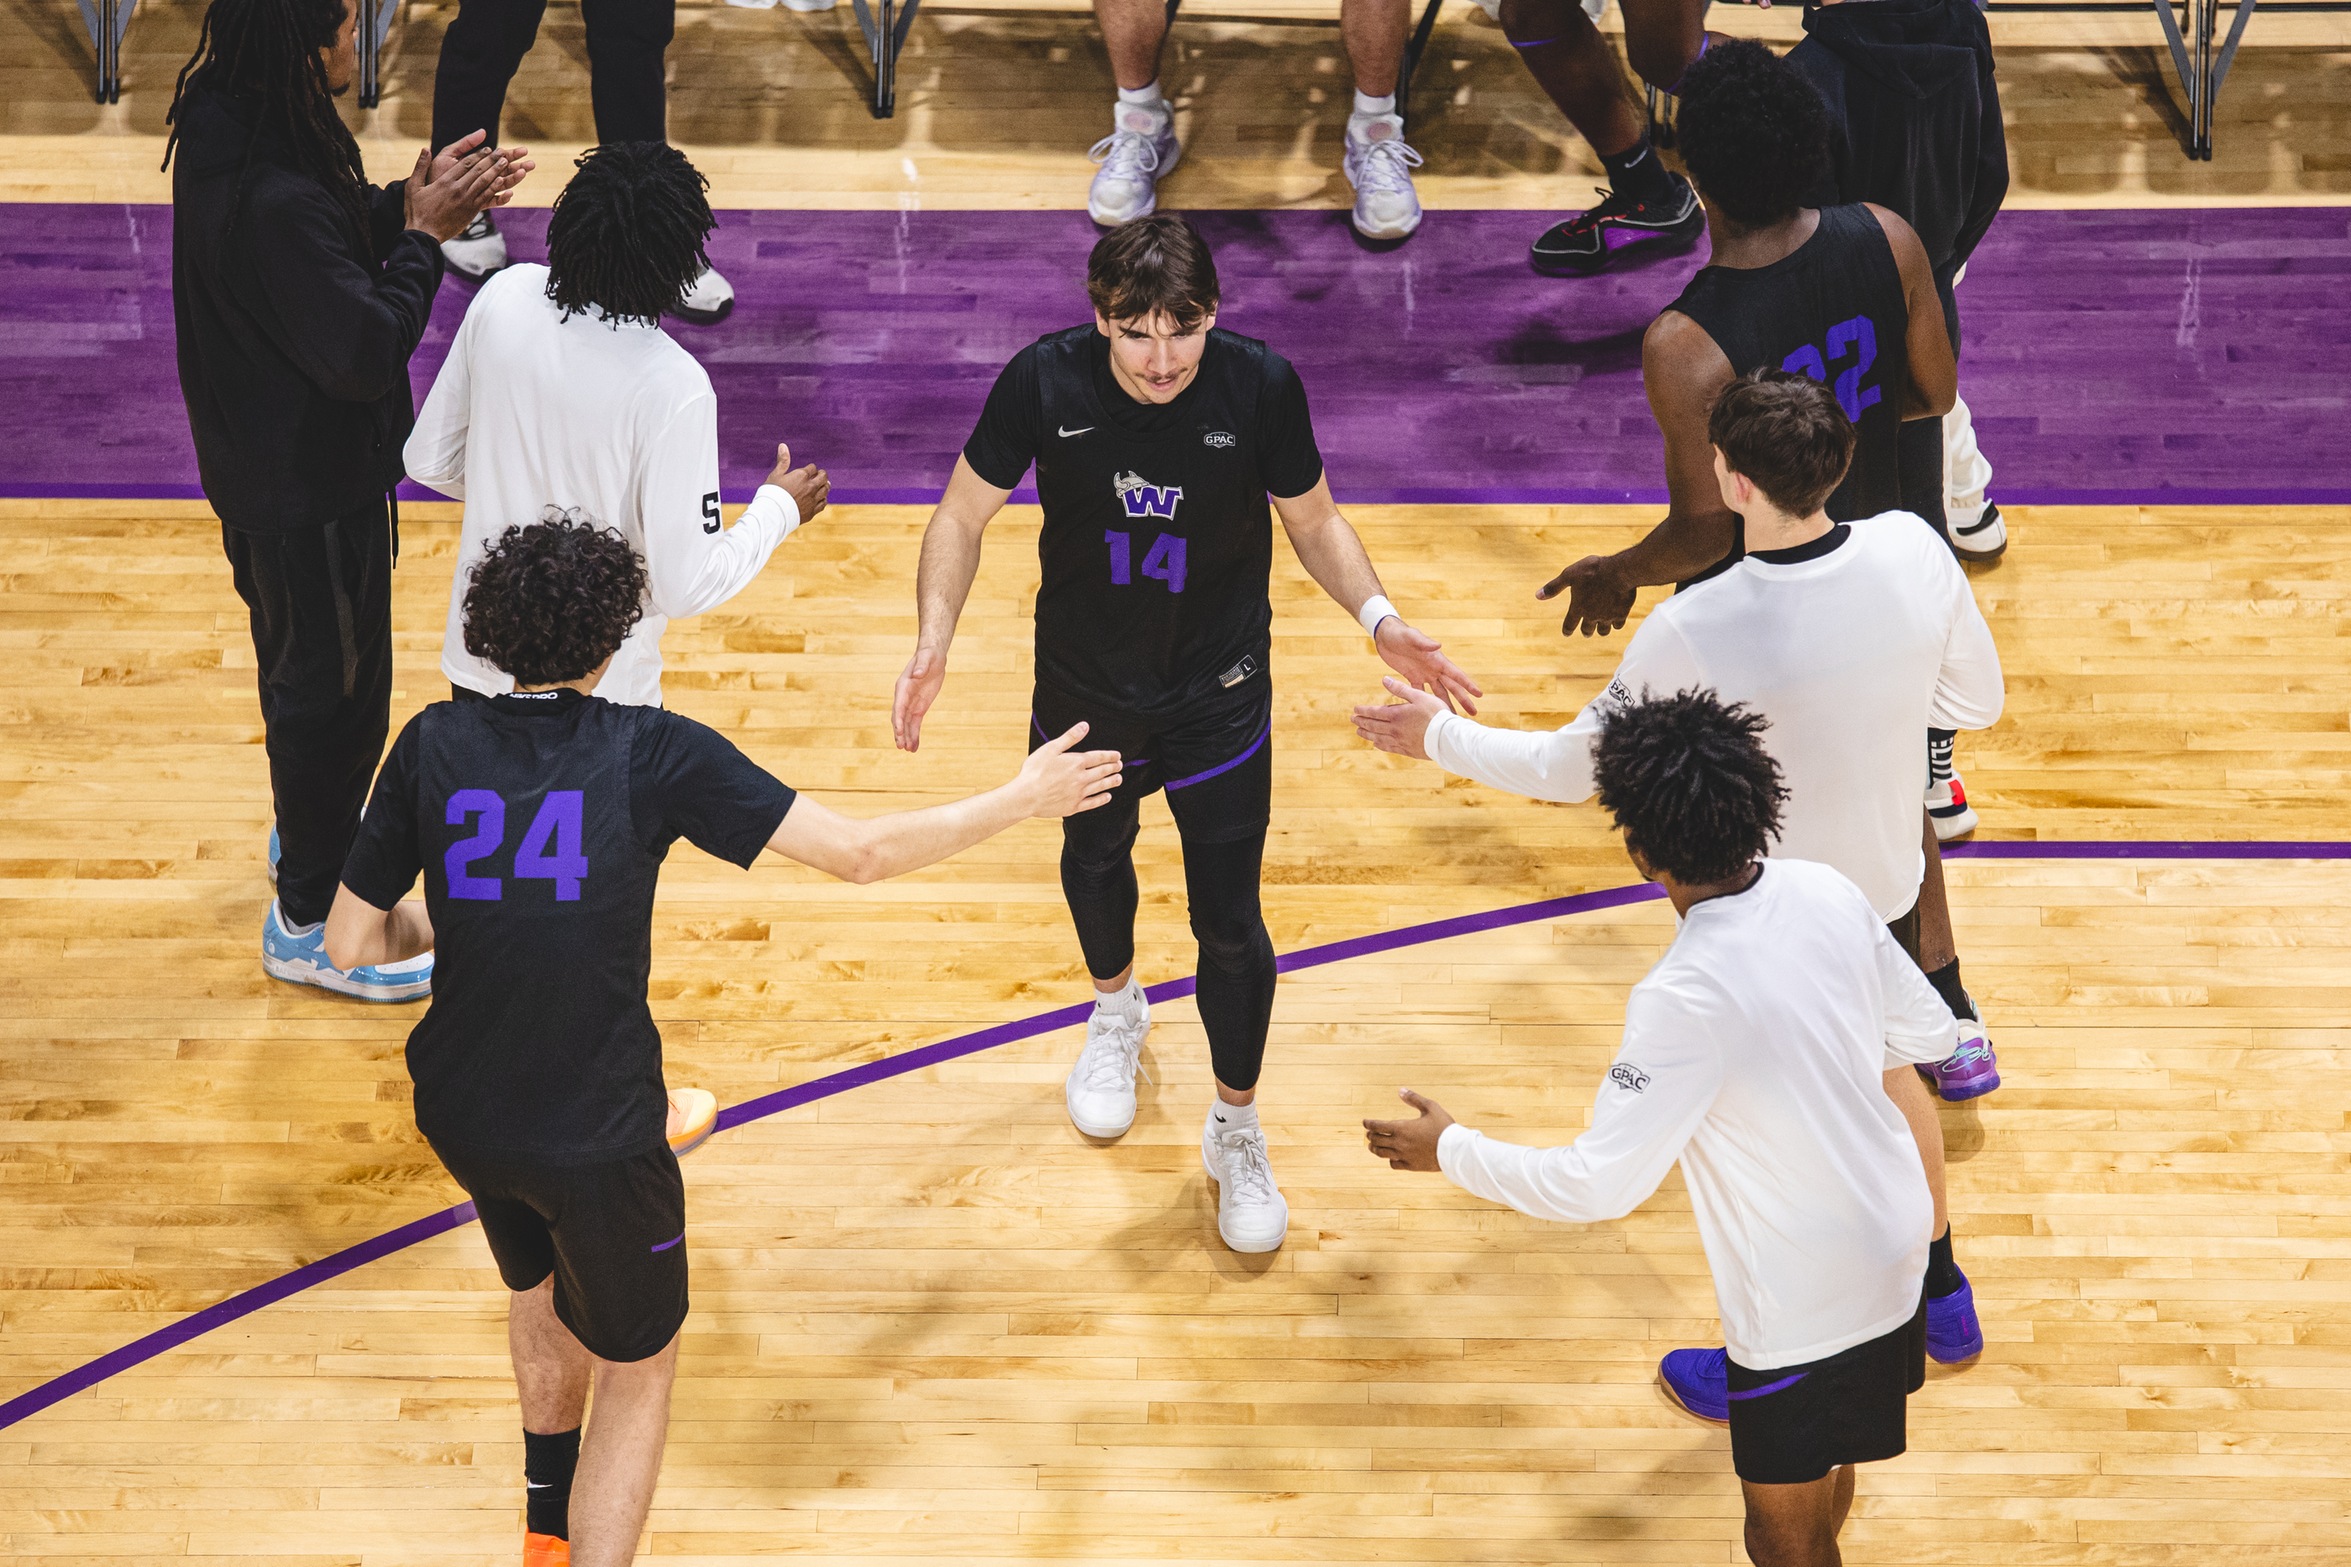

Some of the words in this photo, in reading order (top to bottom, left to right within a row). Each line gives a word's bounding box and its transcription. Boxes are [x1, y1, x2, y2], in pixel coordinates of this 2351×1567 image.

[1121, 485, 1185, 521] W
[1104, 528, 1188, 593] 14
[443, 788, 589, 902] 24
[1611, 1067, 1647, 1091] GPAC
